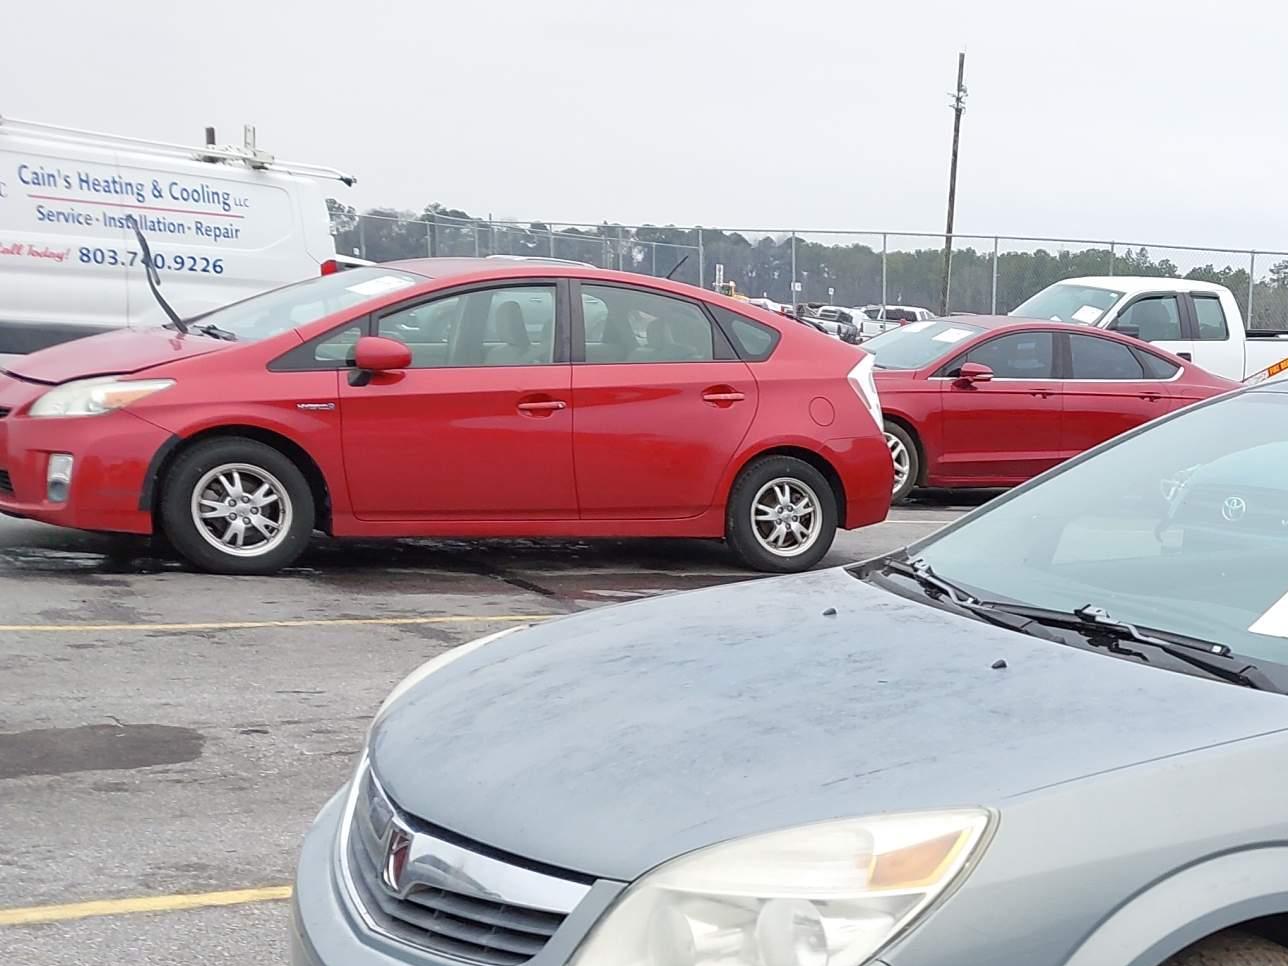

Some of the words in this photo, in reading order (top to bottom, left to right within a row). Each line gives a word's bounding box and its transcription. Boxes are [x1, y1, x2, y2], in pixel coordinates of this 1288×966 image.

[18, 164, 72, 190] Cain's
[77, 171, 145, 203] Heating
[151, 179, 163, 199] &
[169, 181, 232, 212] Cooling
[233, 197, 250, 207] LLC
[36, 204, 93, 226] Service
[195, 221, 240, 242] Repair
[79, 246, 224, 274] 803.70.9226
